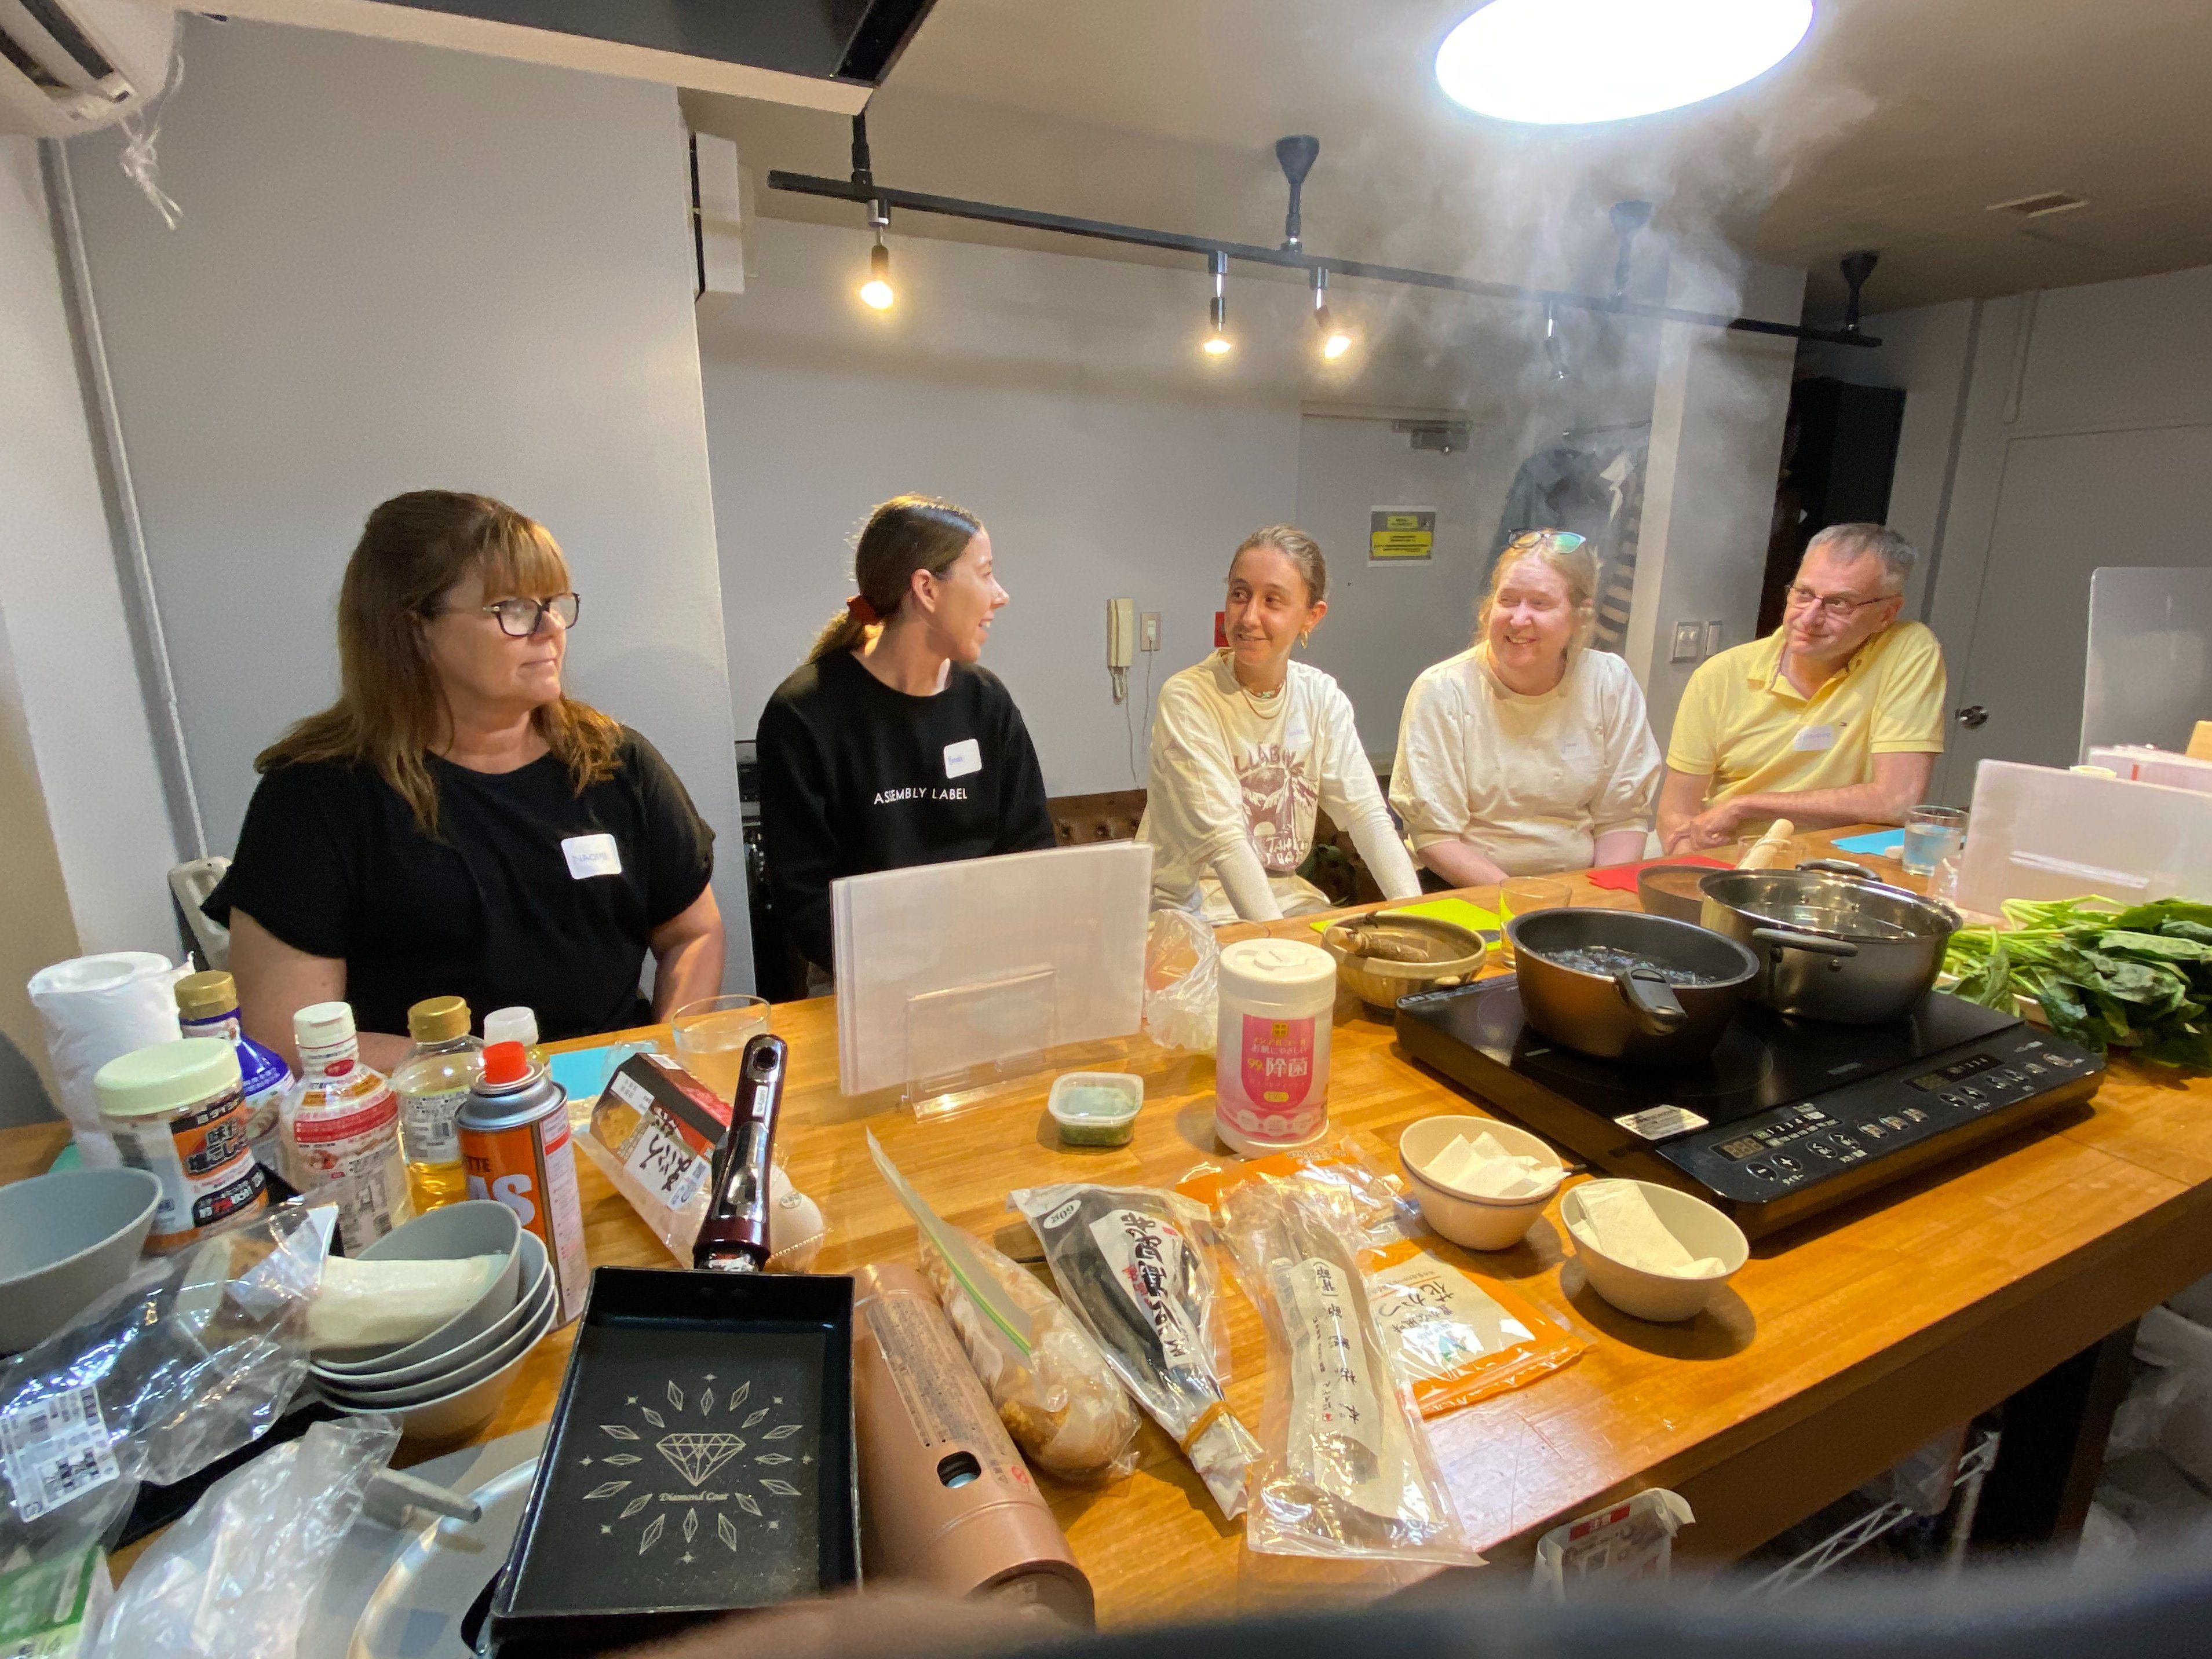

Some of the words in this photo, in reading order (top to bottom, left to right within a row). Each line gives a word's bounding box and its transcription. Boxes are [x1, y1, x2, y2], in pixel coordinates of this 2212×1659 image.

[932, 788, 968, 800] LABEL
[1265, 1057, 1308, 1077] 除菌
[1050, 1204, 1074, 1223] 60g
